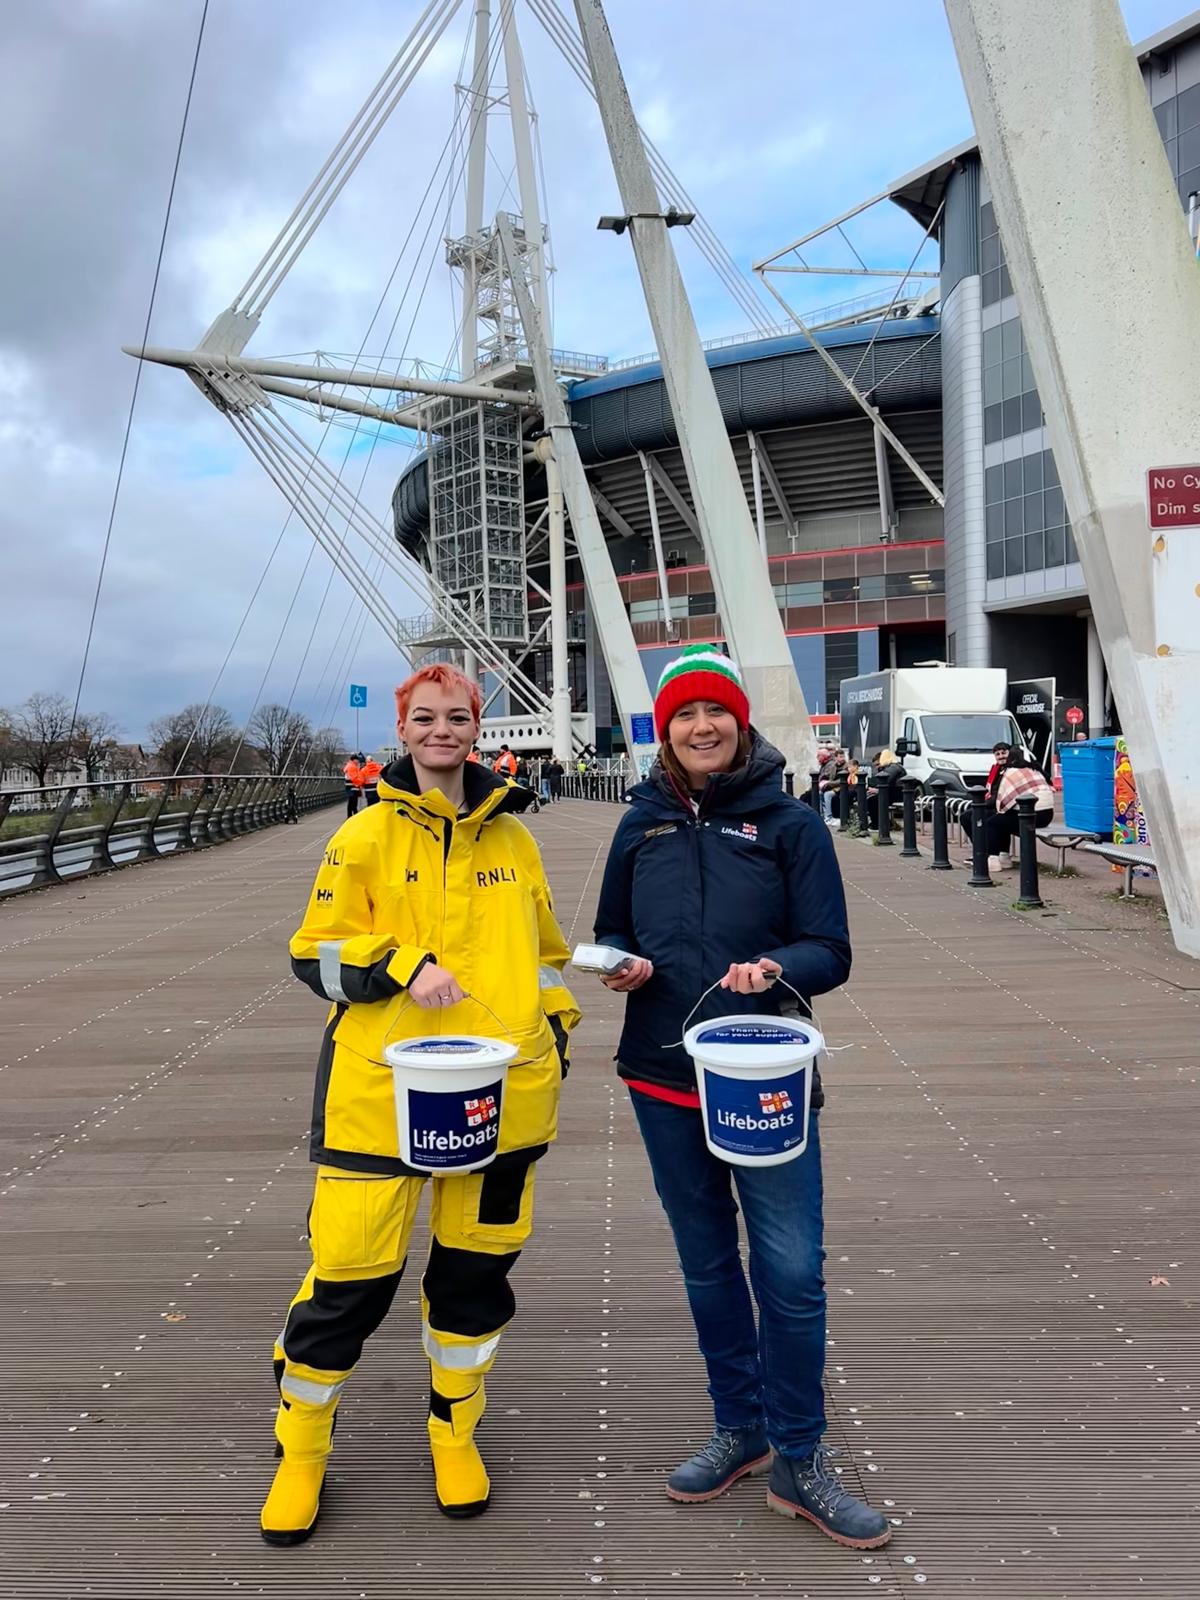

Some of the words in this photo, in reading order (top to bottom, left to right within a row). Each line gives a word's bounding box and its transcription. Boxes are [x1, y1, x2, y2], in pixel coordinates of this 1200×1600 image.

[1154, 477, 1176, 489] No
[1157, 503, 1186, 515] Dim
[476, 867, 517, 887] RNLI
[717, 1109, 794, 1131] Lifeboats
[413, 1123, 498, 1151] Lifeboats
